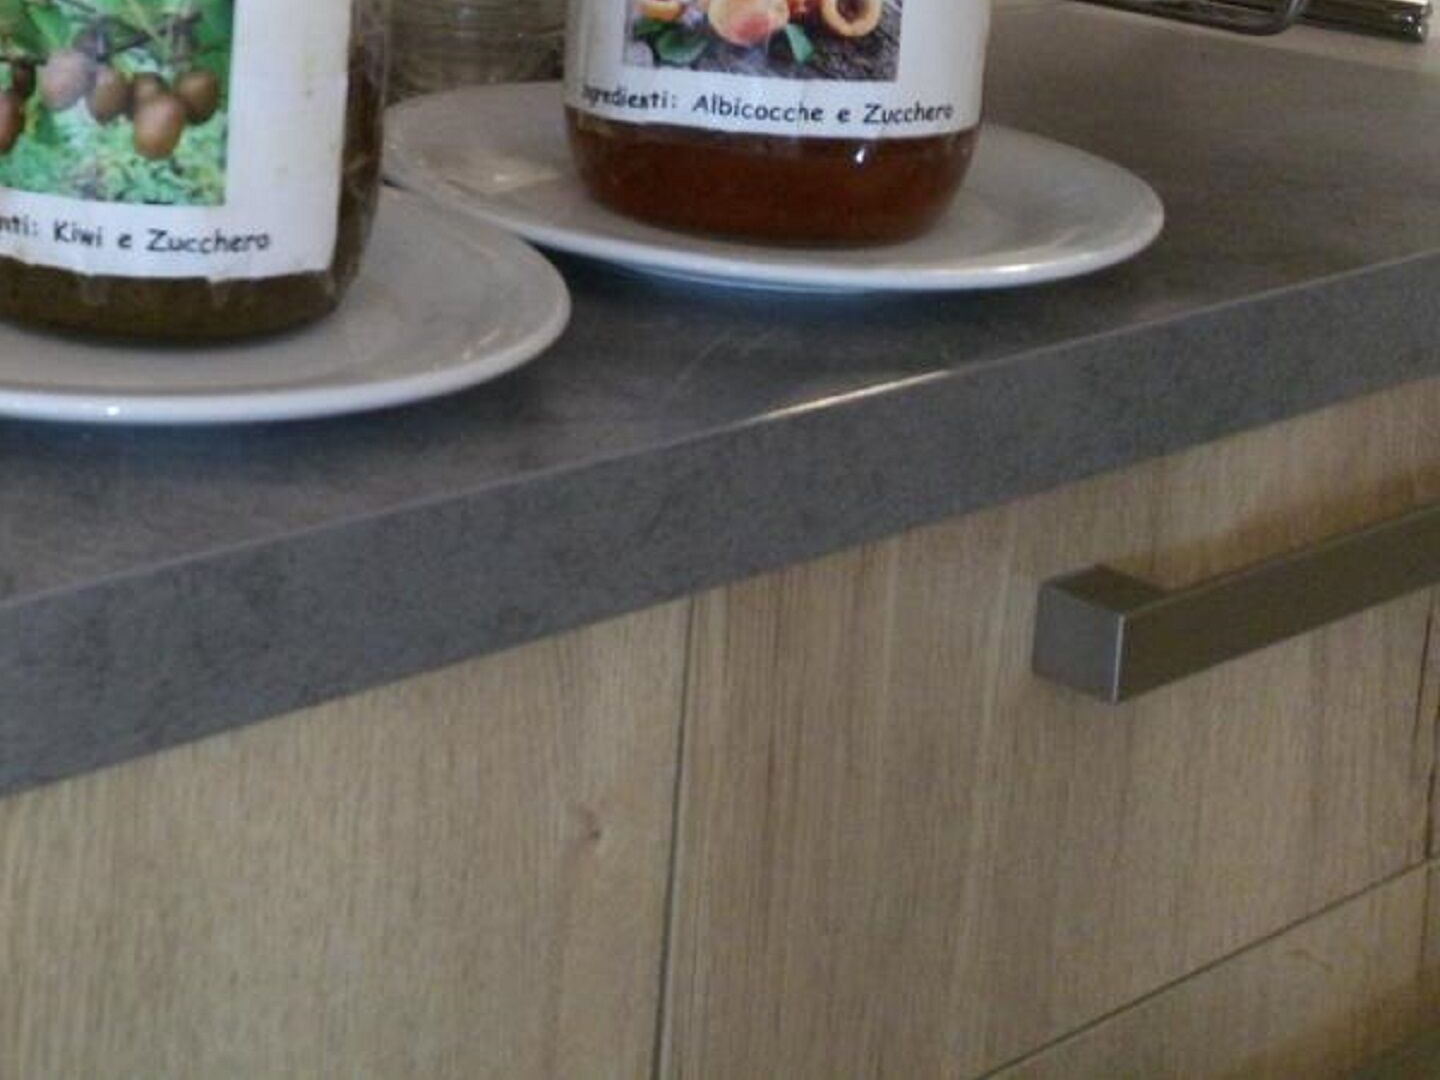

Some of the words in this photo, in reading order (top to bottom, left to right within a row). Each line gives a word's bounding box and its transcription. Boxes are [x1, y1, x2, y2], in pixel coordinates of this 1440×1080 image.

[693, 94, 825, 123] Albicocche
[837, 109, 851, 123] e
[863, 102, 953, 126] Zucchero
[54, 219, 103, 248] Kiwi
[117, 232, 133, 250] e
[146, 227, 271, 255] Zucchero
